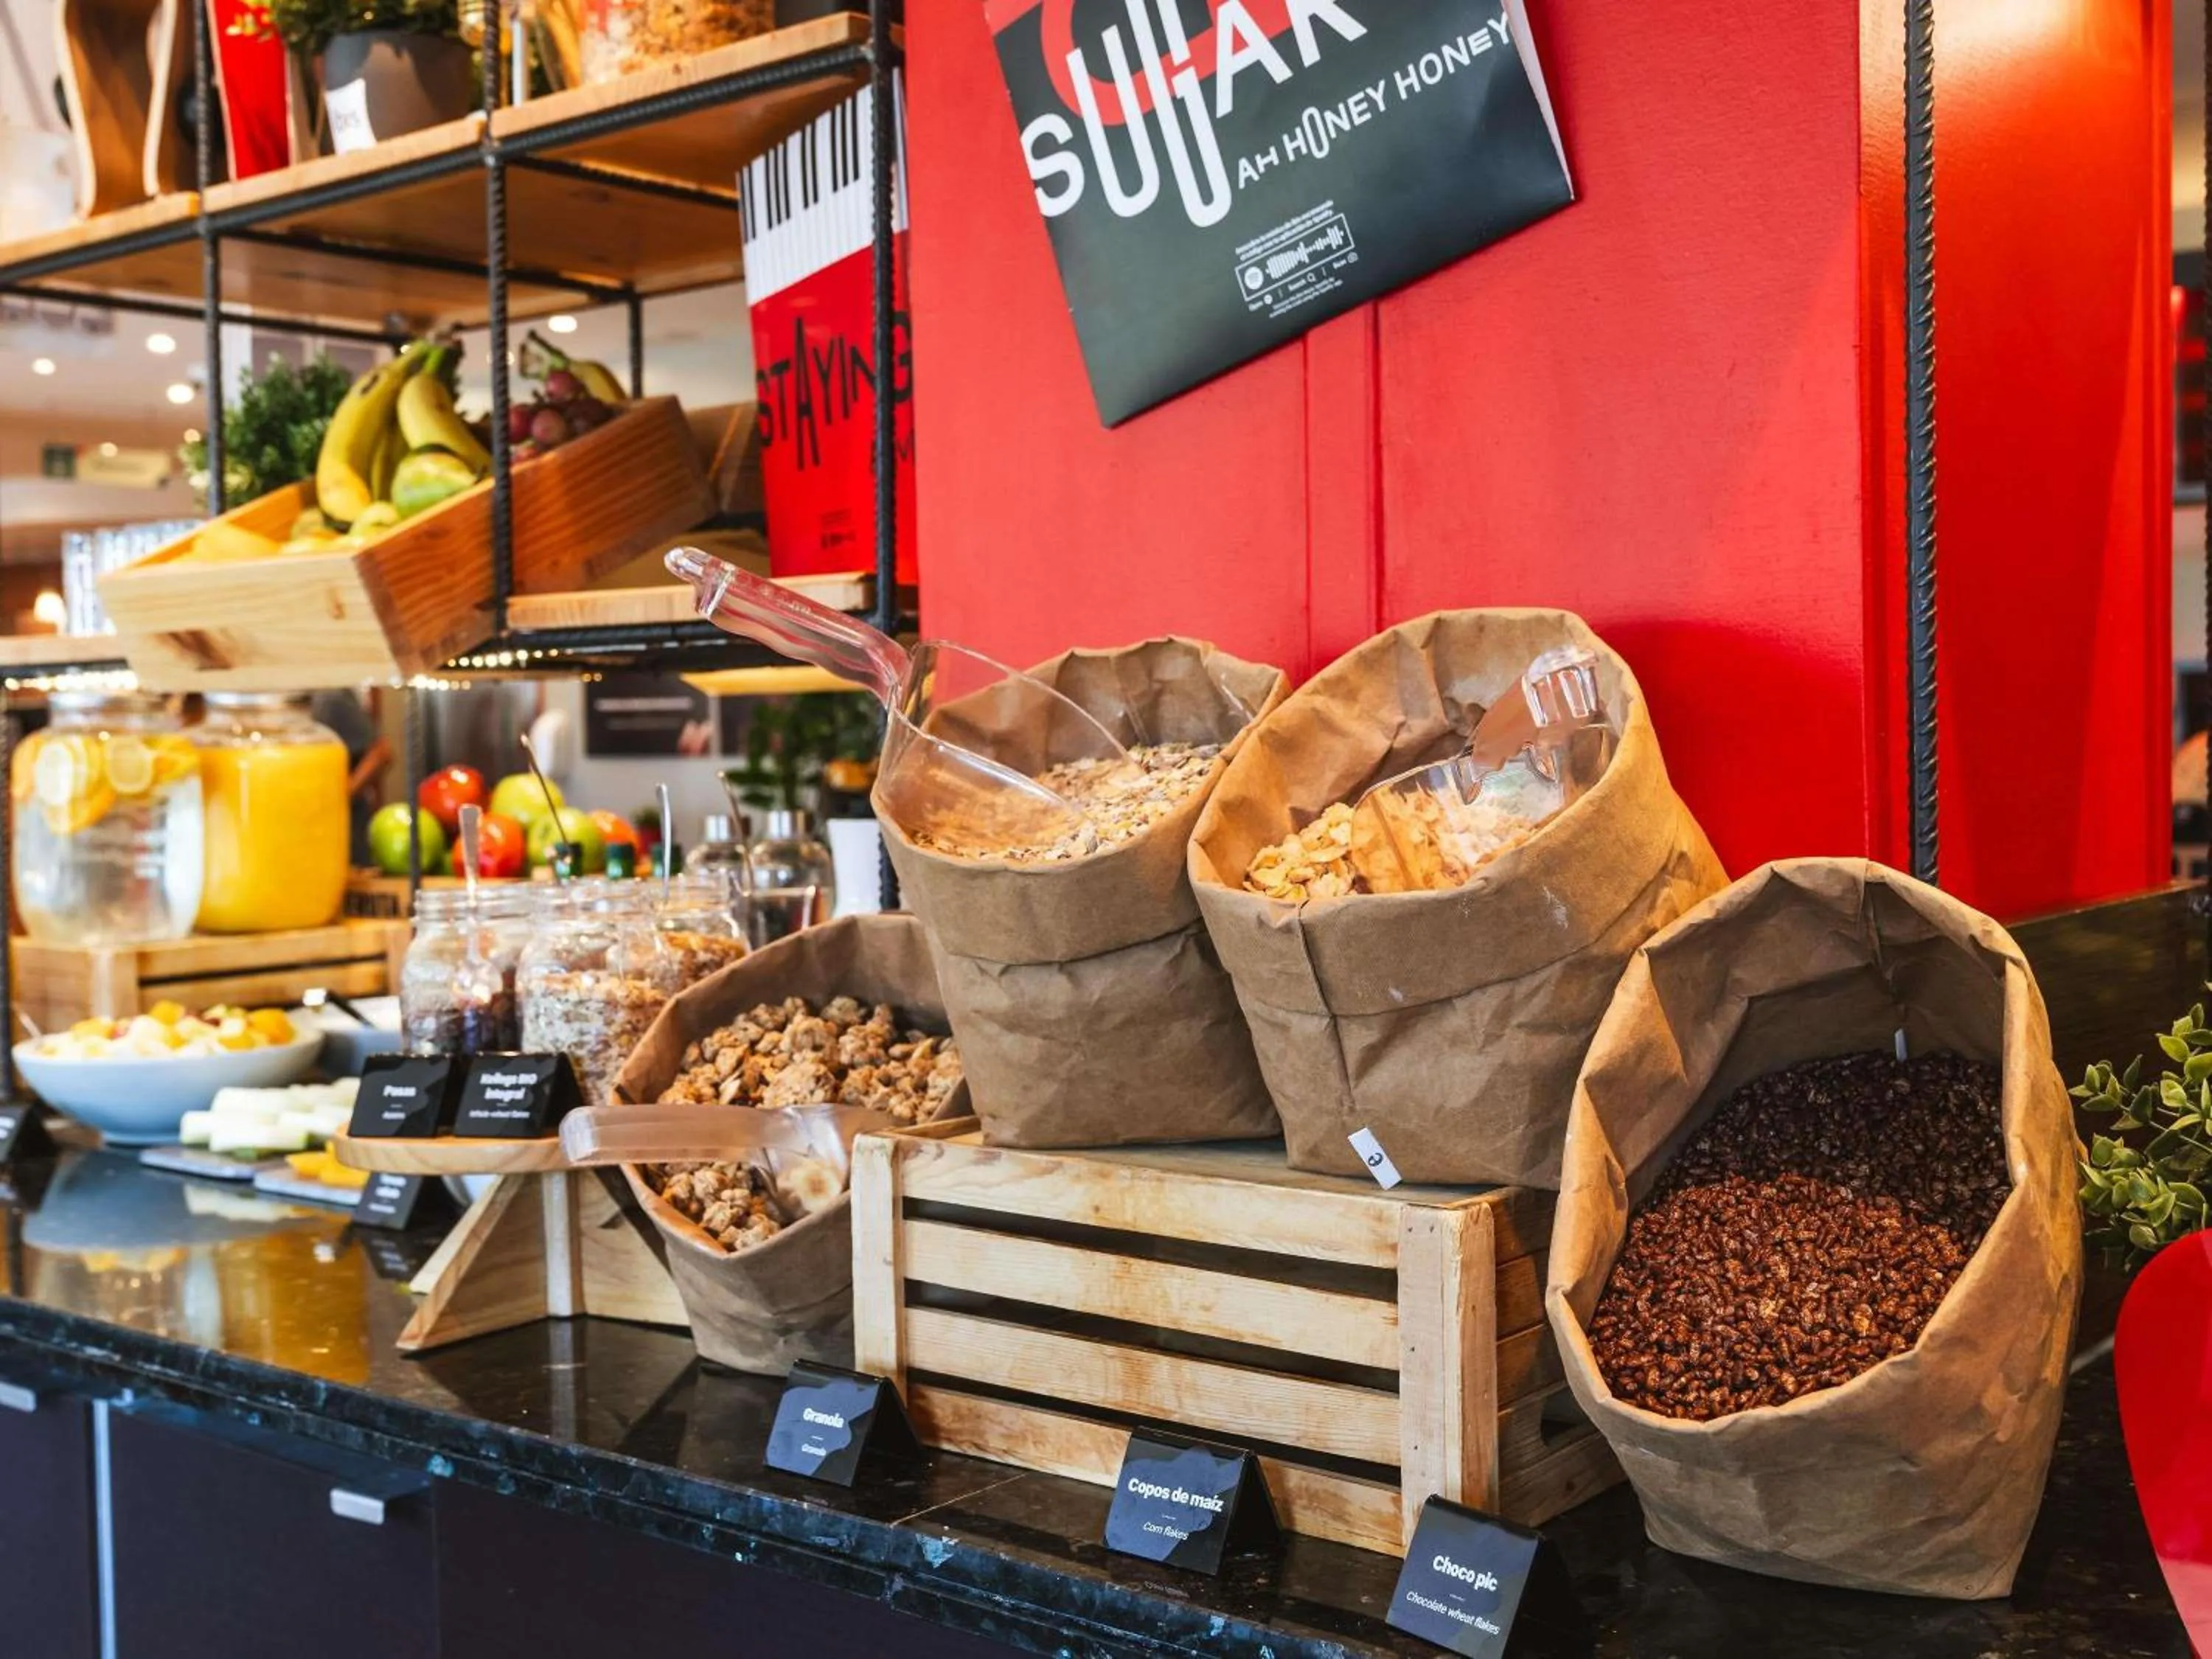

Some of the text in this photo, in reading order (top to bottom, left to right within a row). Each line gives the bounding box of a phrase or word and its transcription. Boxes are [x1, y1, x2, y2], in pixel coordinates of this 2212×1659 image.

[1238, 10, 1511, 189] AH HONEY HONEY
[803, 1408, 844, 1428] Granola
[1127, 1478, 1225, 1512] Copos de maíz
[1433, 1554, 1498, 1592] Choco pic
[1406, 1590, 1501, 1635] Chocolate wheat flakes
